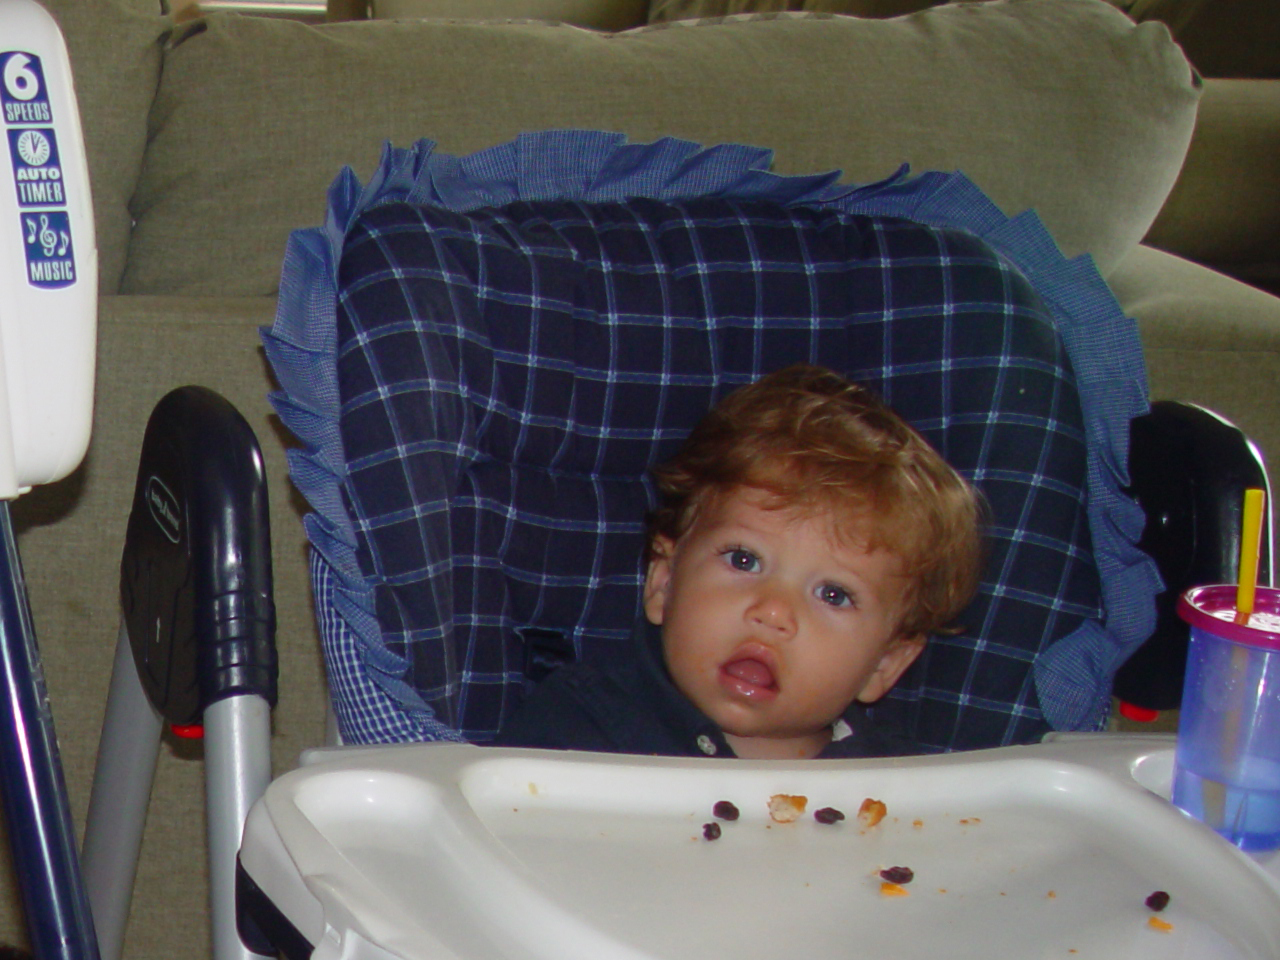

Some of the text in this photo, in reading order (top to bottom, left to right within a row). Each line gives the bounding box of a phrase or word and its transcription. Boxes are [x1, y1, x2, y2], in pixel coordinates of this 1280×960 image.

[4, 53, 39, 101] 6
[5, 102, 50, 122] SPEEDS
[17, 167, 60, 180] AUTO
[18, 181, 63, 203] TIMER
[30, 261, 73, 281] MUSIC
